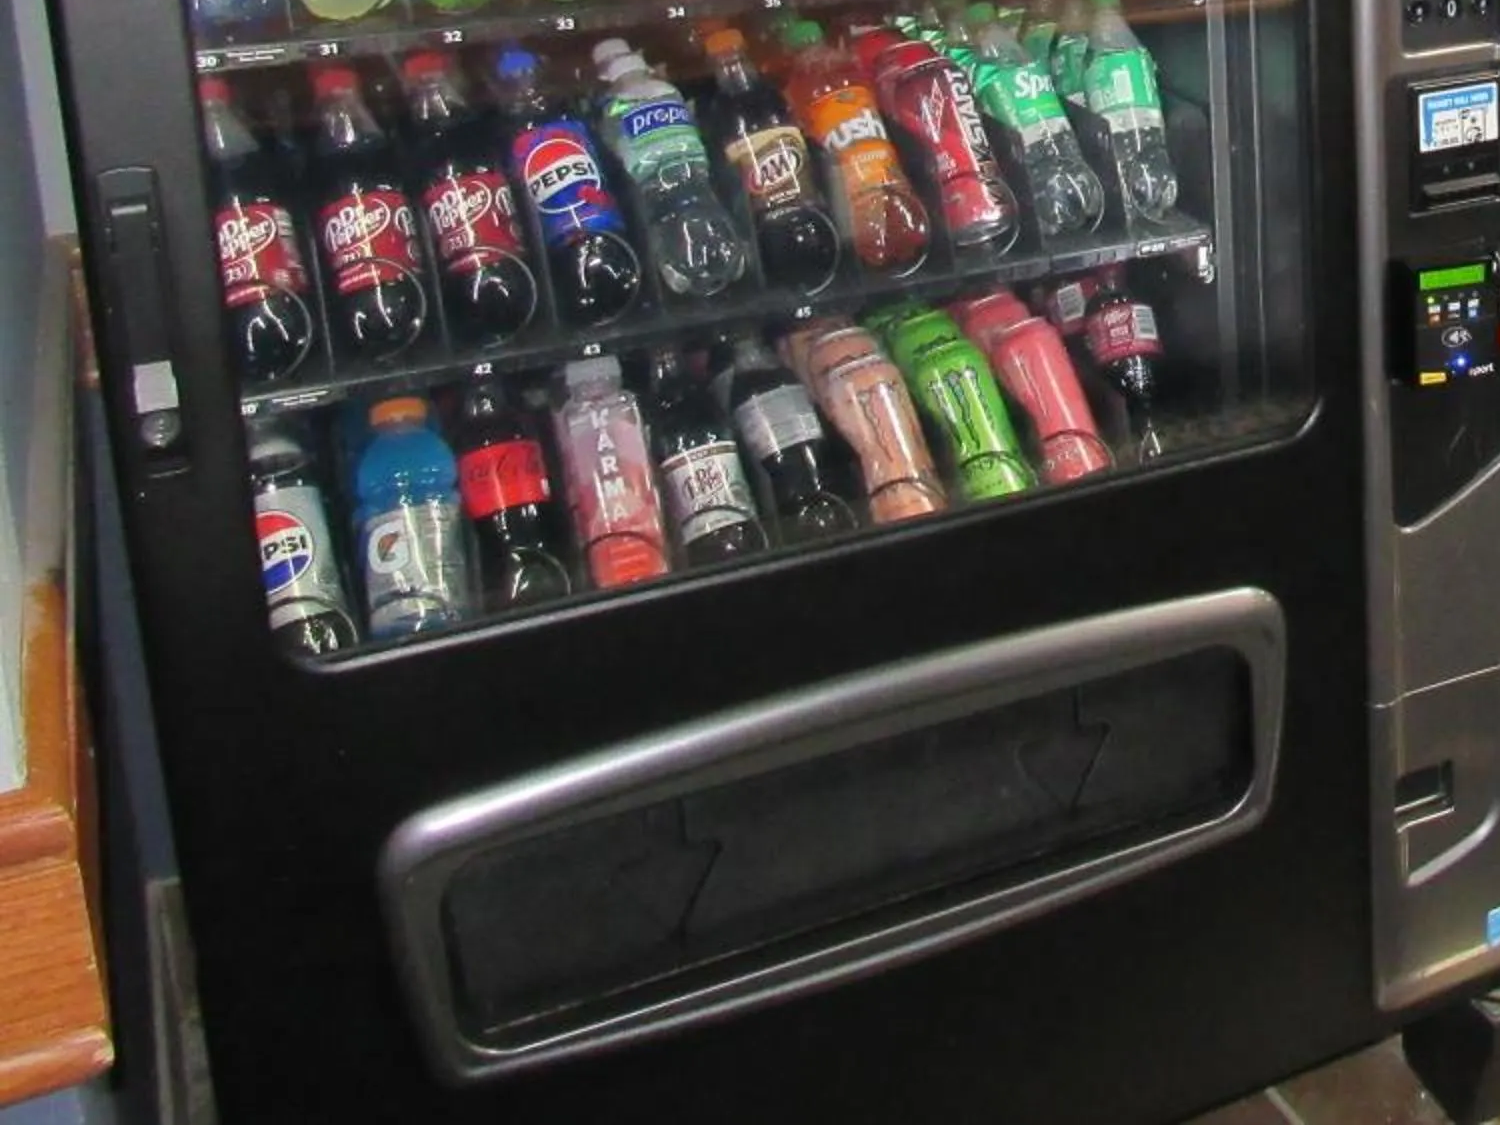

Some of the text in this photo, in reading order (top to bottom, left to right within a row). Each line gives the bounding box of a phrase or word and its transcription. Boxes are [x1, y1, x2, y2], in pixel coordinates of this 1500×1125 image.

[667, 6, 685, 19] 34
[1446, 0, 1457, 18] 0
[443, 31, 463, 43] 32
[319, 43, 338, 56] 31
[823, 108, 887, 153] rush
[530, 161, 595, 196] PEPSI
[582, 343, 601, 357] 43
[263, 533, 307, 560] PSI
